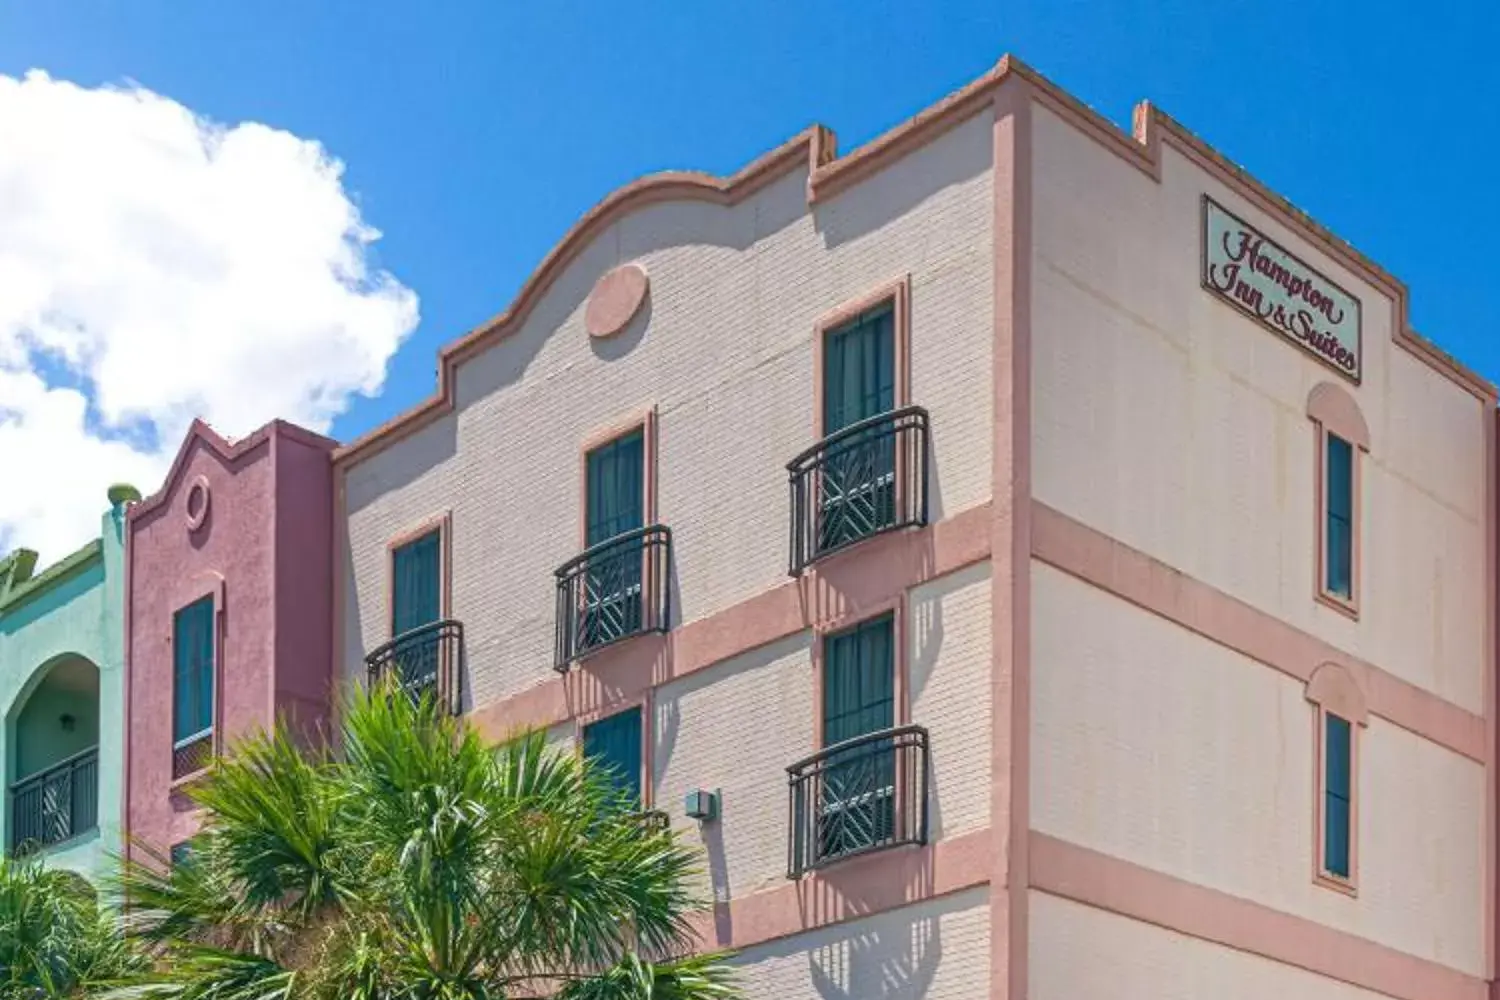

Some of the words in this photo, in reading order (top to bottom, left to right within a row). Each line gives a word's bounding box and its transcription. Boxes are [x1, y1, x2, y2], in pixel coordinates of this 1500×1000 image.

[1210, 263, 1273, 319] Inn
[1273, 304, 1290, 330] &
[1289, 309, 1356, 370] Suites
[1223, 229, 1343, 324] Hampton
